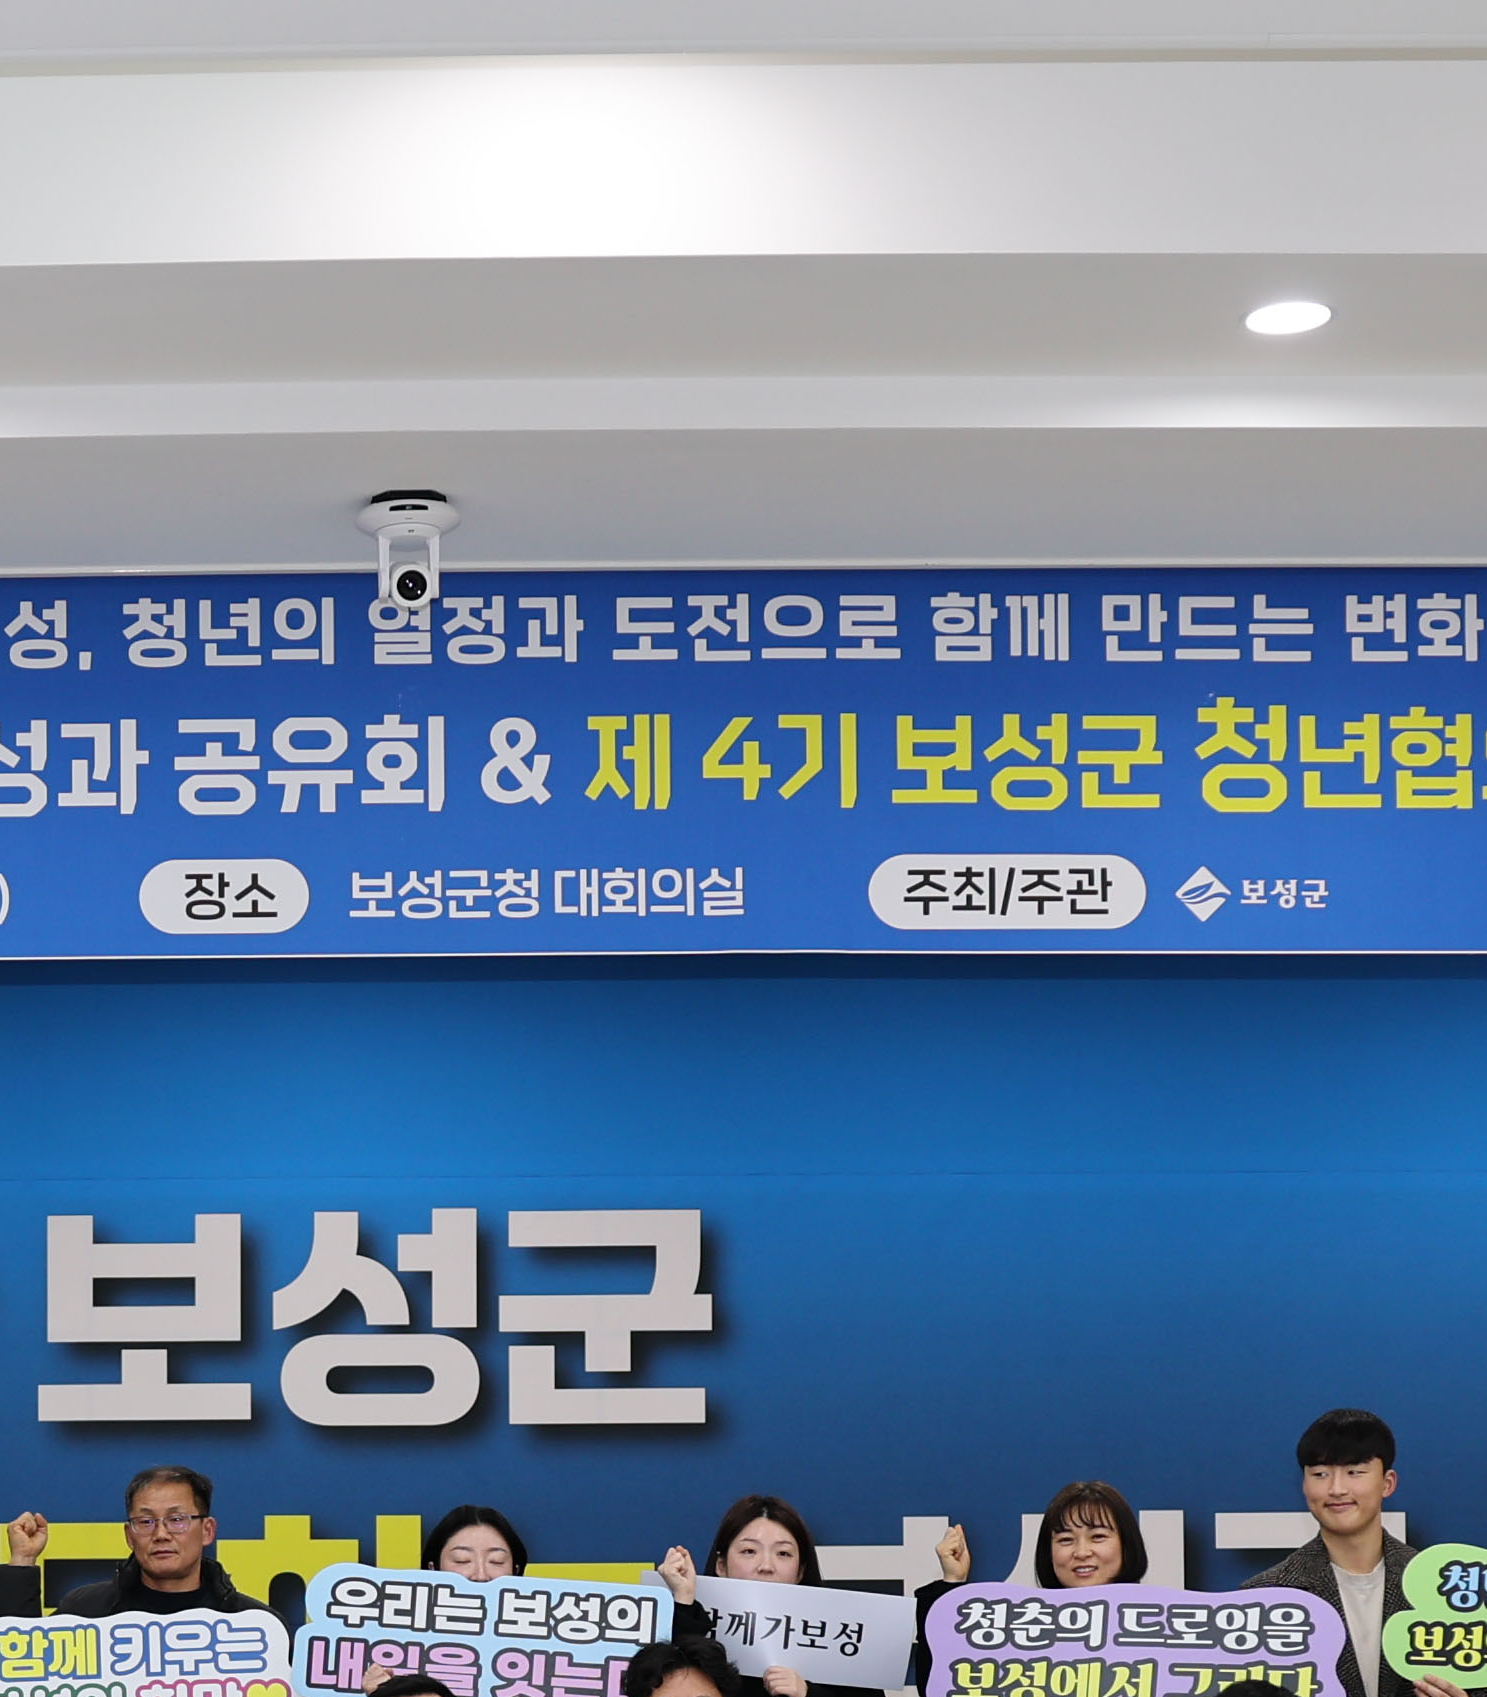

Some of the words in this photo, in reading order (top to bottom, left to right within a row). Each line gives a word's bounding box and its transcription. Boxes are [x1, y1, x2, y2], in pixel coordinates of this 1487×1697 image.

[122, 597, 335, 668] 청년의
[367, 594, 584, 665] 열정과
[612, 593, 901, 662] 도전으로
[930, 592, 1070, 662] 함께
[1101, 593, 1314, 663] 만드는
[173, 714, 446, 816] 공유회
[480, 717, 552, 806] &
[584, 713, 671, 810] 제
[702, 712, 858, 809] 4기
[891, 713, 1164, 811] 보성군
[183, 872, 277, 924] 장소
[349, 866, 540, 921] 보성군청
[554, 865, 745, 918] 대회의실
[902, 865, 1114, 918] 주최/주관
[1239, 878, 1330, 911] 보성군
[37, 1207, 713, 1426] 보성군
[327, 1577, 487, 1637] 우리는
[496, 1589, 658, 1645] 보성의
[957, 1598, 1108, 1649] 청춘의
[1116, 1601, 1314, 1652] 드로잉을
[110, 1619, 267, 1676] 키우는
